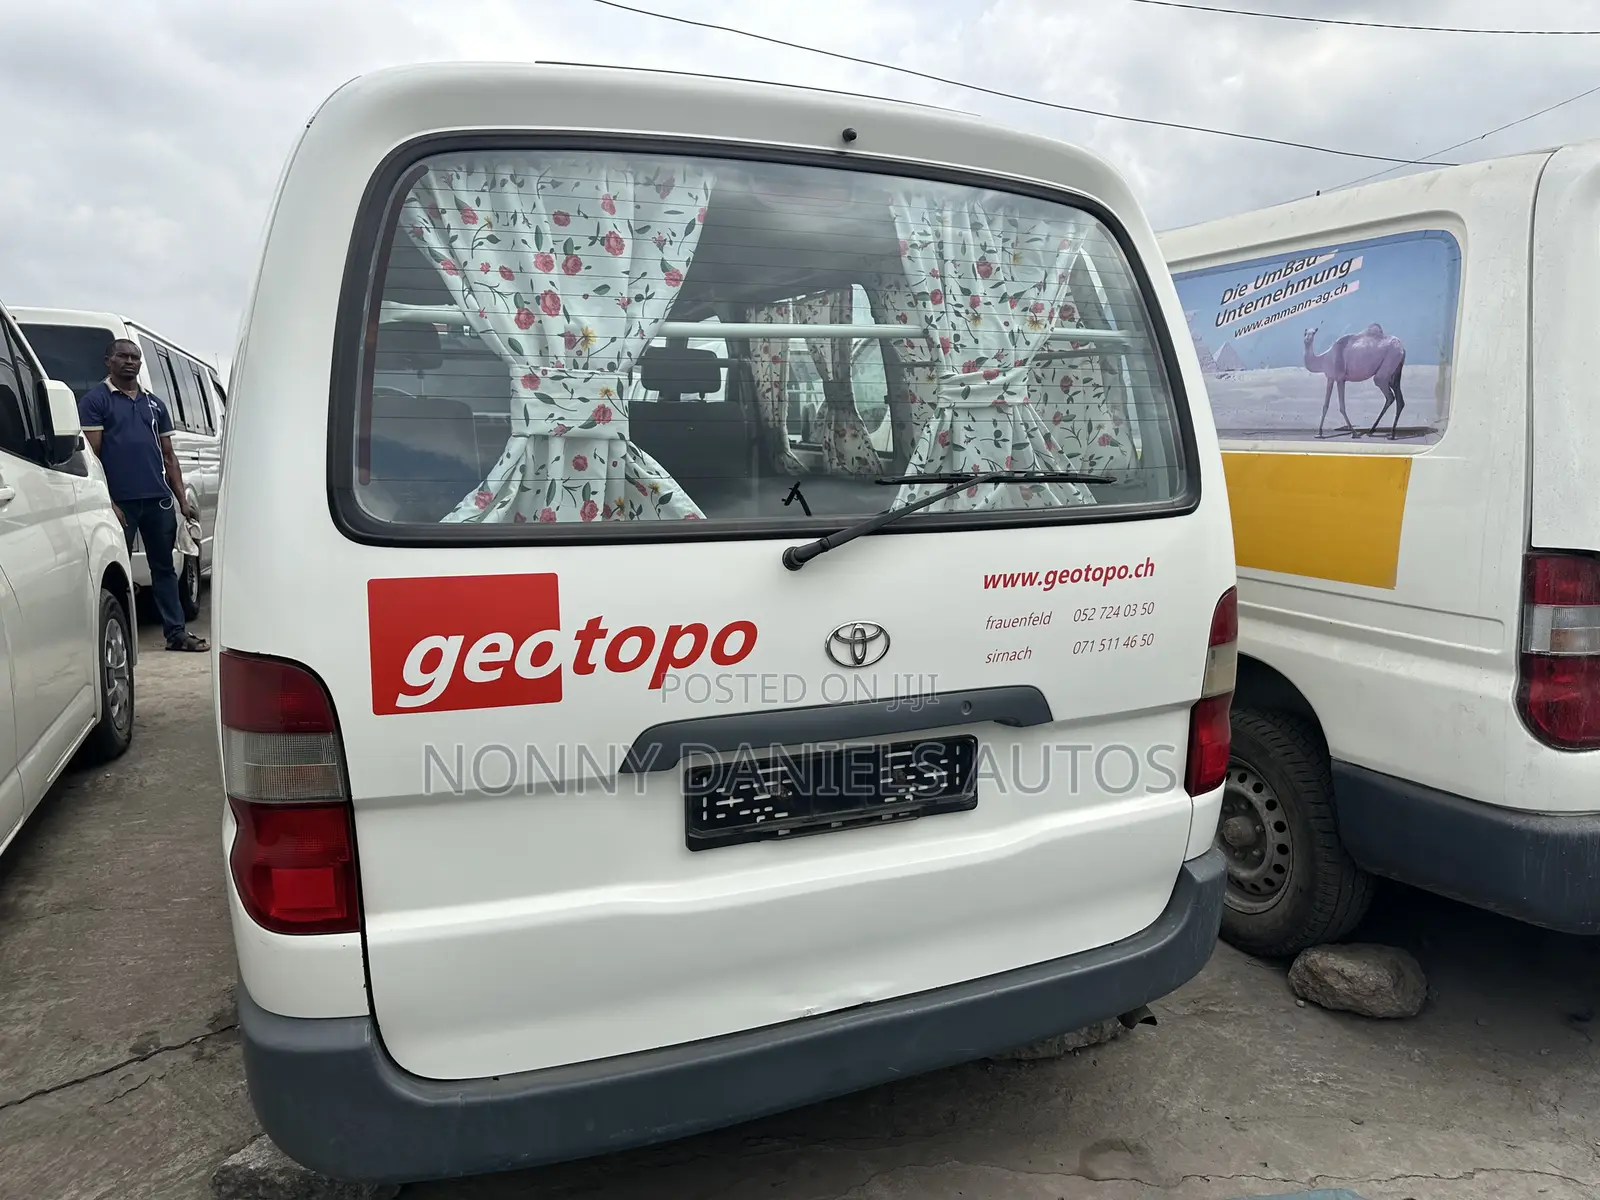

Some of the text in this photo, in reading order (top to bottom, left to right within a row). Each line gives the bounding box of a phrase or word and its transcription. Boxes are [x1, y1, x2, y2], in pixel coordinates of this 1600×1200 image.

[1215, 258, 1354, 328] Unternehmung
[1220, 282, 1248, 306] Die
[1234, 282, 1348, 338] www.ammann-ag.ch
[983, 556, 1155, 592] www.geotopo.ch
[985, 601, 1155, 630] frauenfeld 052 724 03 50
[395, 613, 758, 708] geotopo
[985, 632, 1154, 664] sirnach 071 511 46 50
